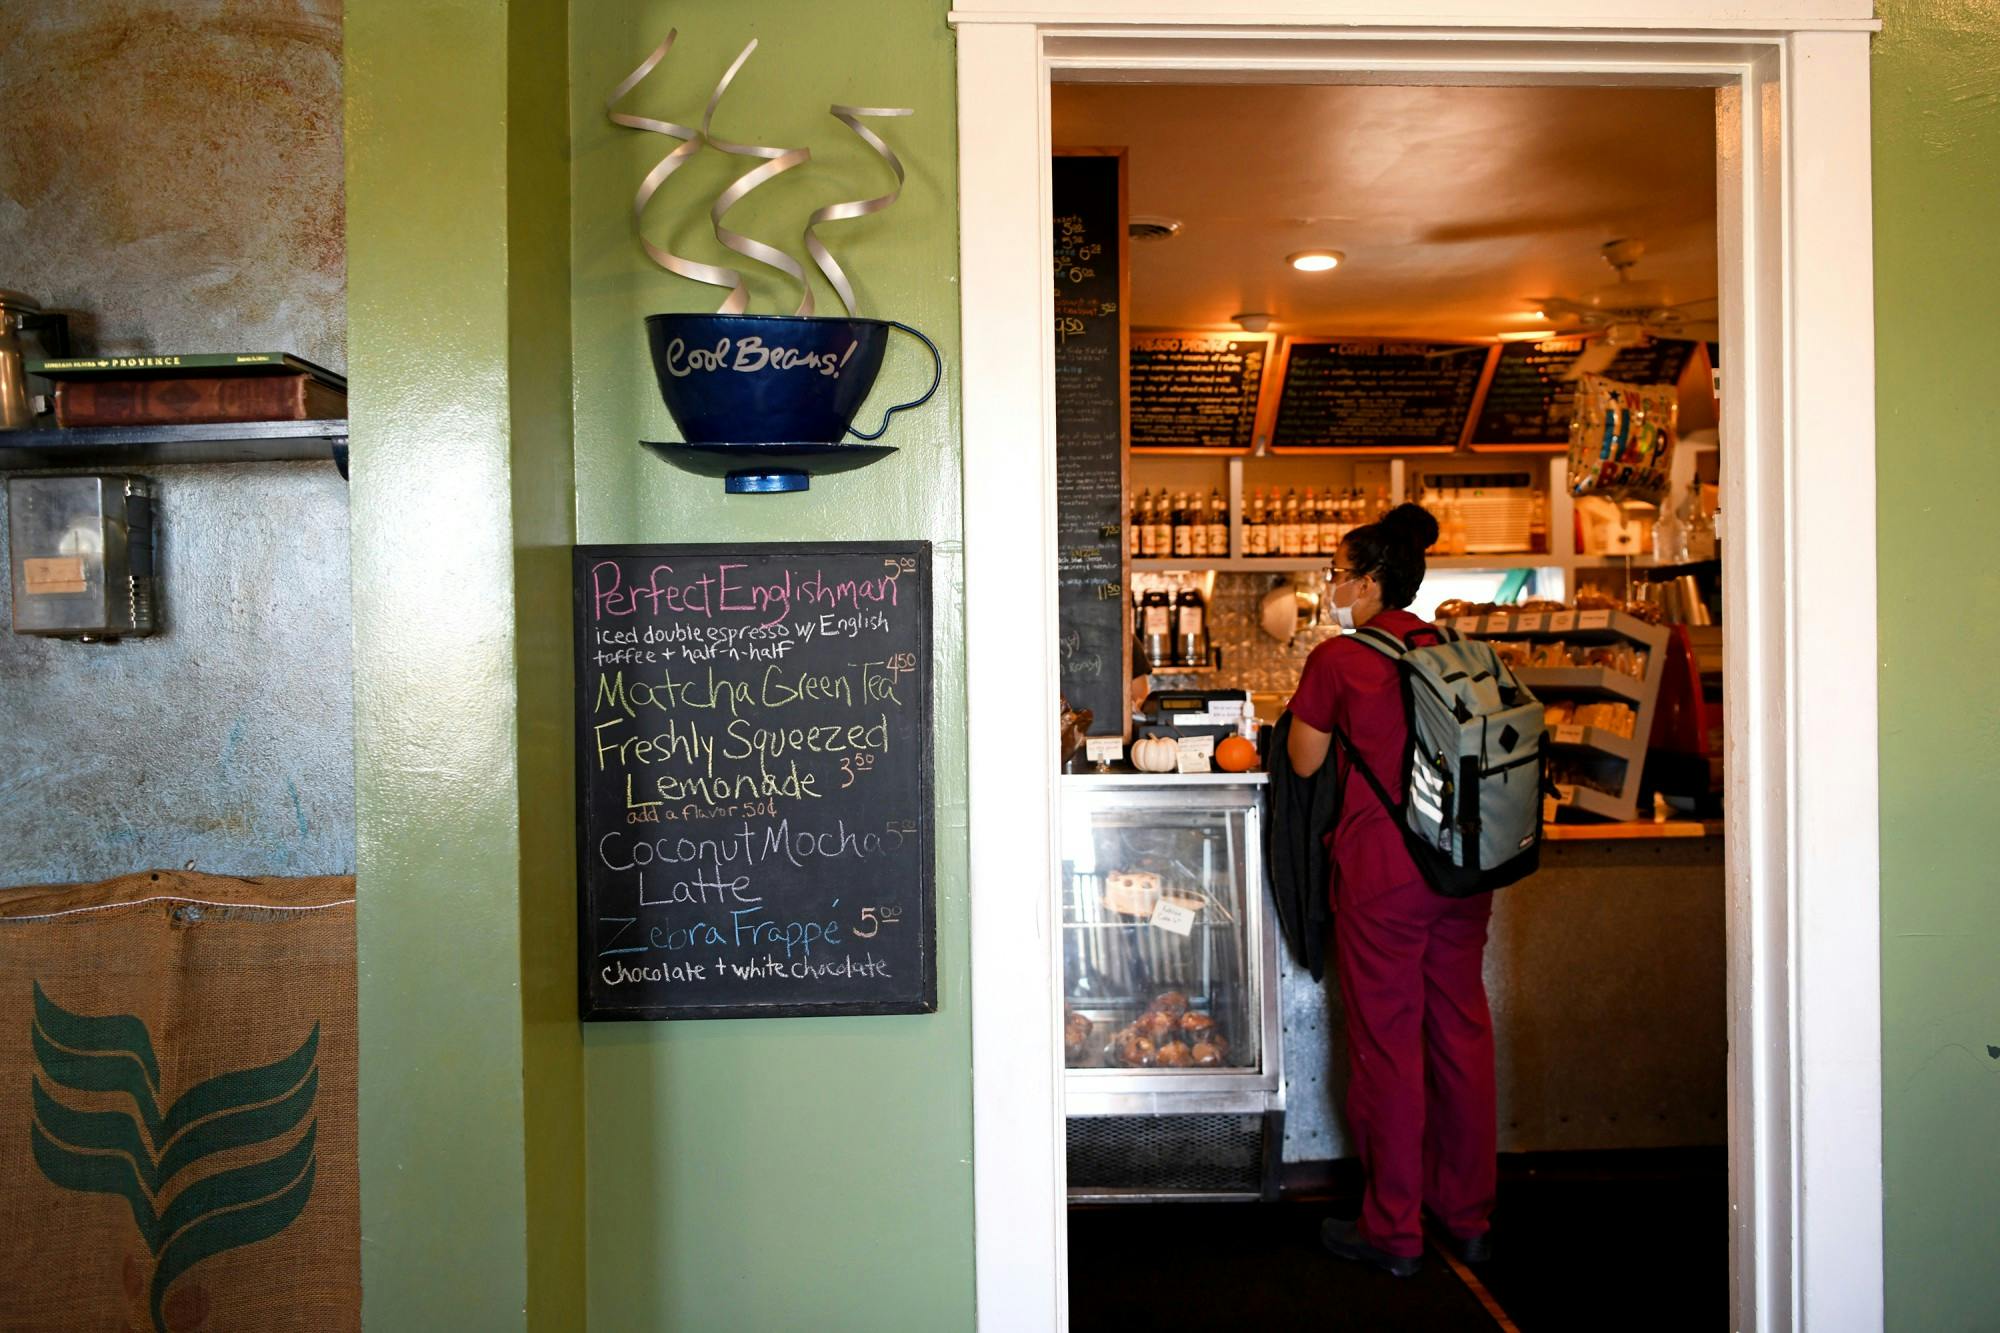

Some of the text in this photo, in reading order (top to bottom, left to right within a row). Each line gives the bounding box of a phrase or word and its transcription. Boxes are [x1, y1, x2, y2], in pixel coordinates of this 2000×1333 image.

[112, 356, 181, 367] PROVENCE
[666, 336, 858, 379] Cool Beans!
[592, 560, 897, 628] Perfect Englishman
[596, 623, 639, 645] iced
[644, 621, 701, 645] double
[707, 623, 790, 647] espresso
[820, 608, 889, 637] English
[593, 649, 657, 666] toffee
[594, 660, 902, 718] Matcha Green Tea
[594, 713, 889, 778] Freshly Squeezed
[626, 760, 823, 809] Lemonade
[626, 803, 660, 825] add
[665, 810, 679, 821] a
[682, 802, 736, 821] flavor
[600, 818, 884, 871] Coconut Mocha
[639, 865, 763, 907] Latte
[599, 898, 843, 959] Zebra Frappé
[731, 954, 788, 979] white
[791, 952, 893, 979] chocolate
